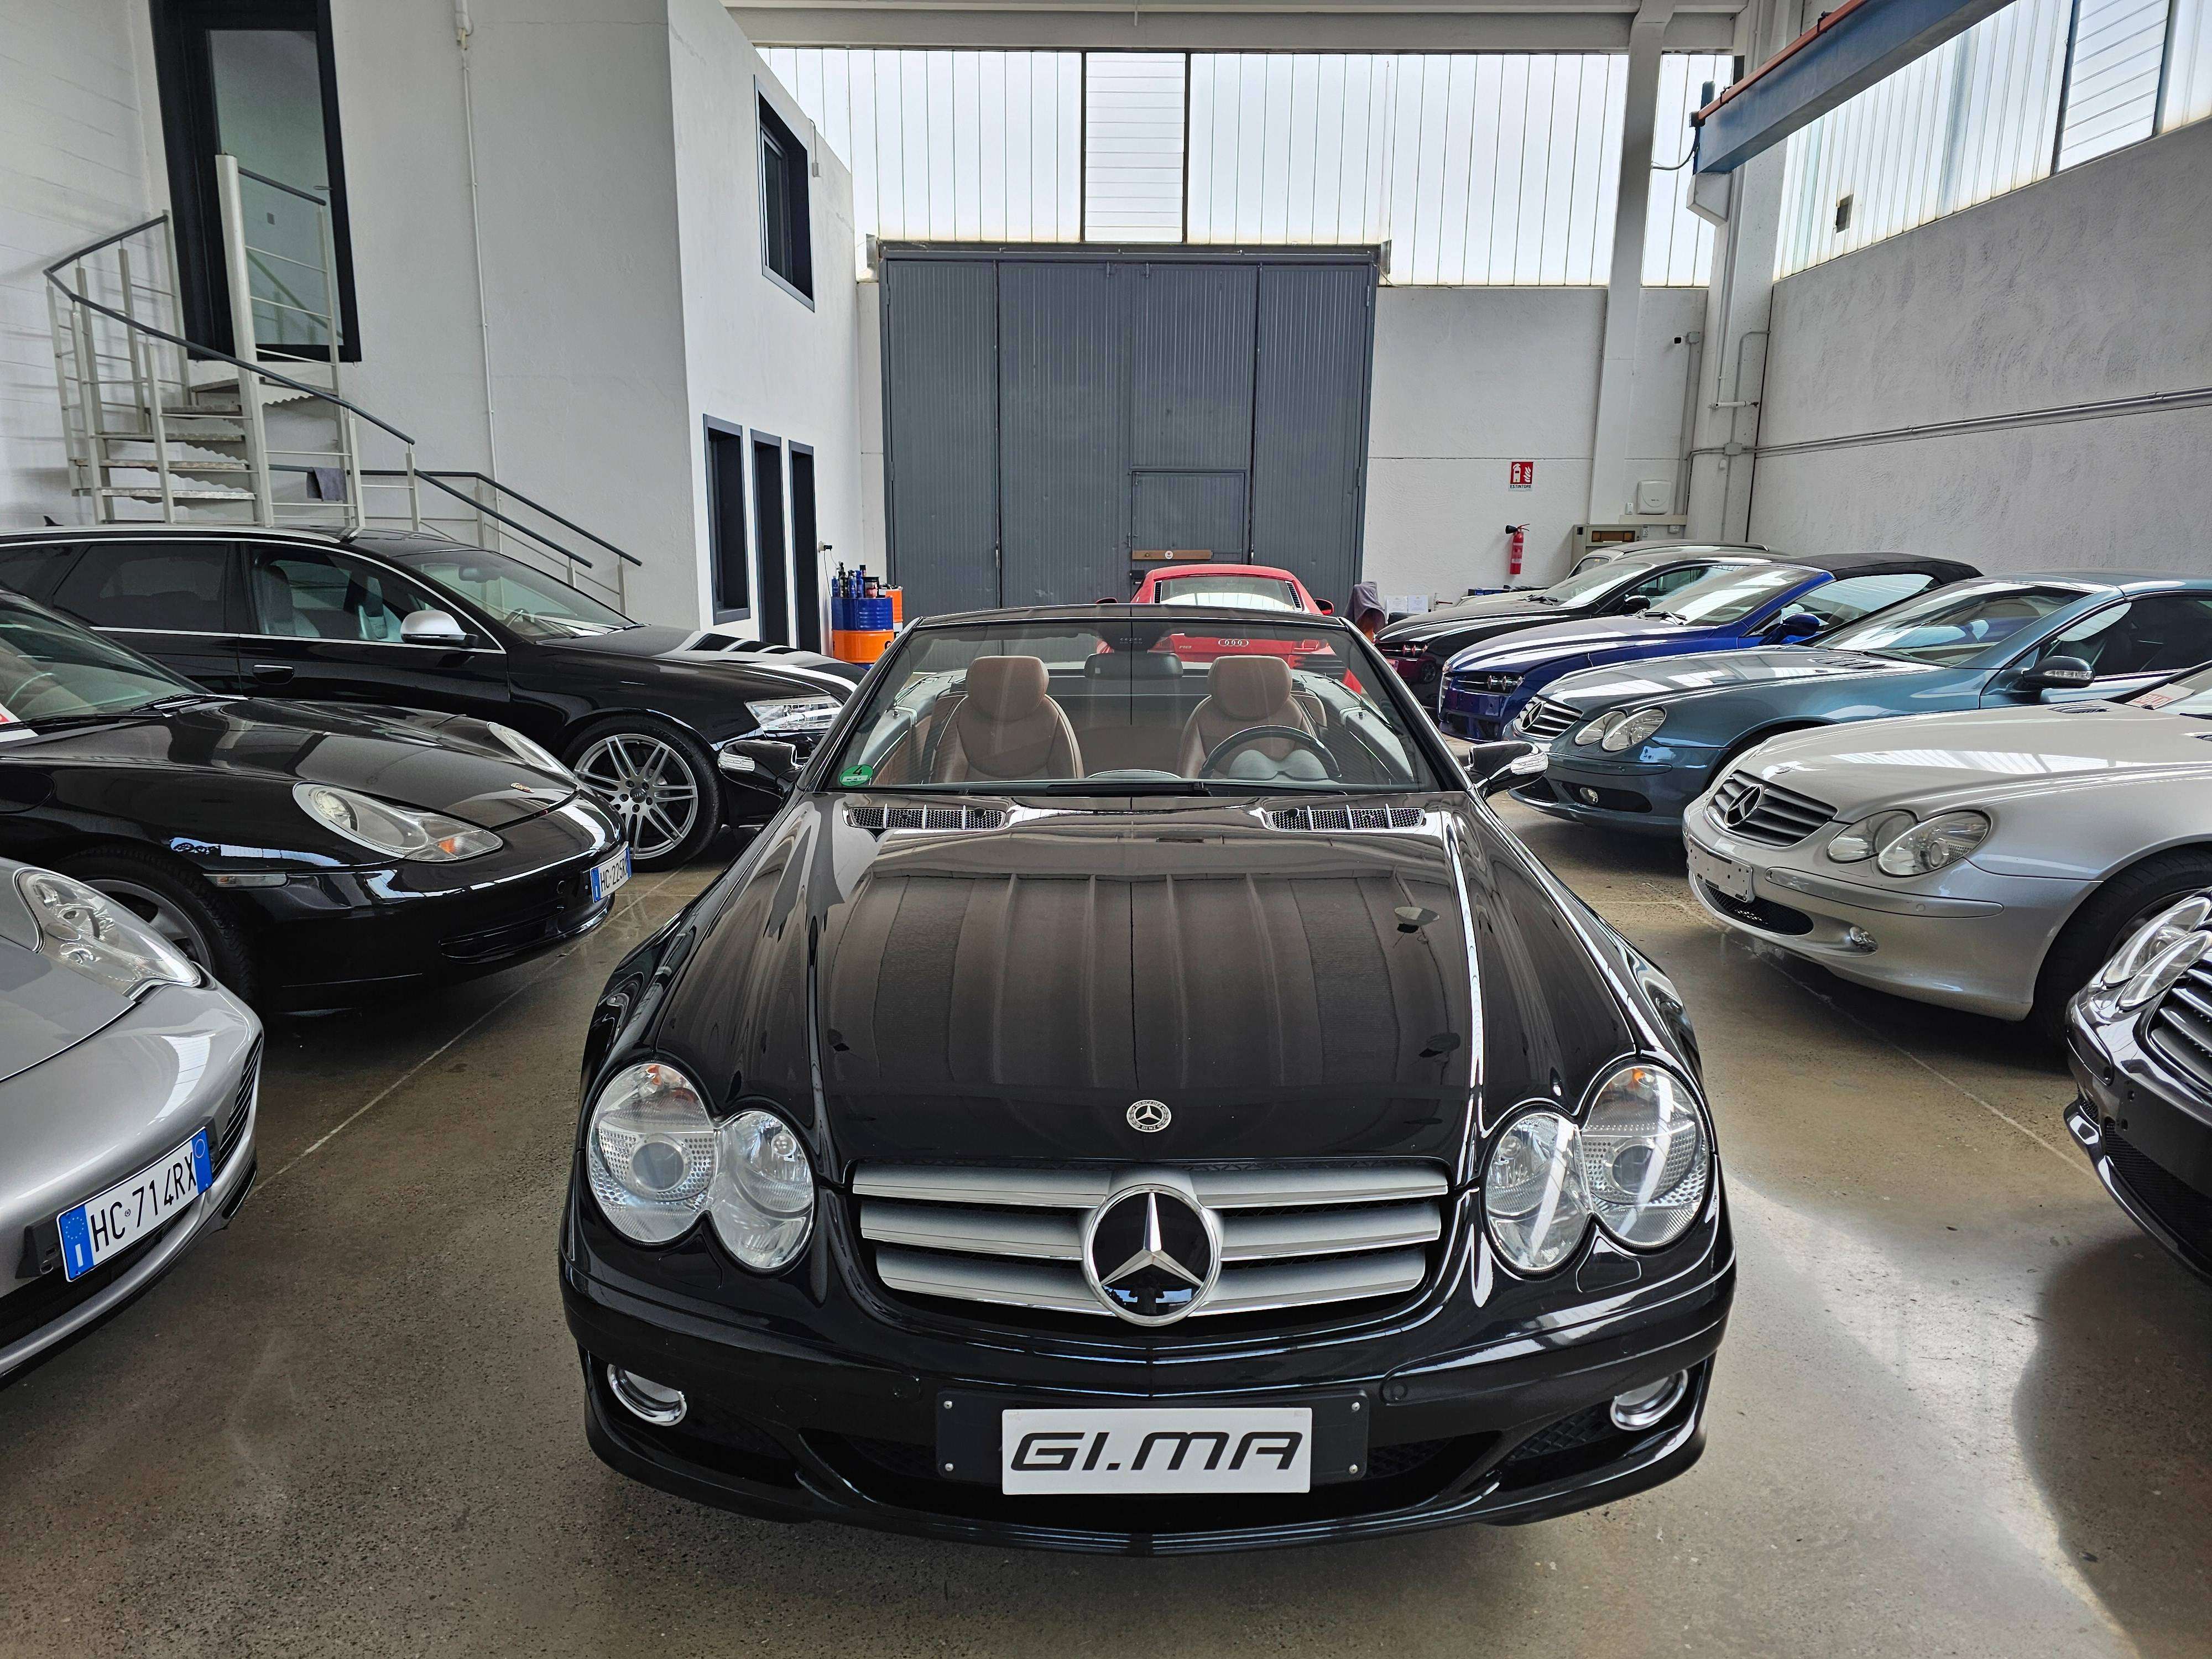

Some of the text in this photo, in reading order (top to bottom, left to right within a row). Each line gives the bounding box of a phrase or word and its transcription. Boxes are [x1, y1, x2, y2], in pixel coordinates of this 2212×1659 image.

[853, 765, 863, 776] 4
[90, 1151, 197, 1253] HC 714RX
[1010, 1431, 1303, 1472] GI.MA
